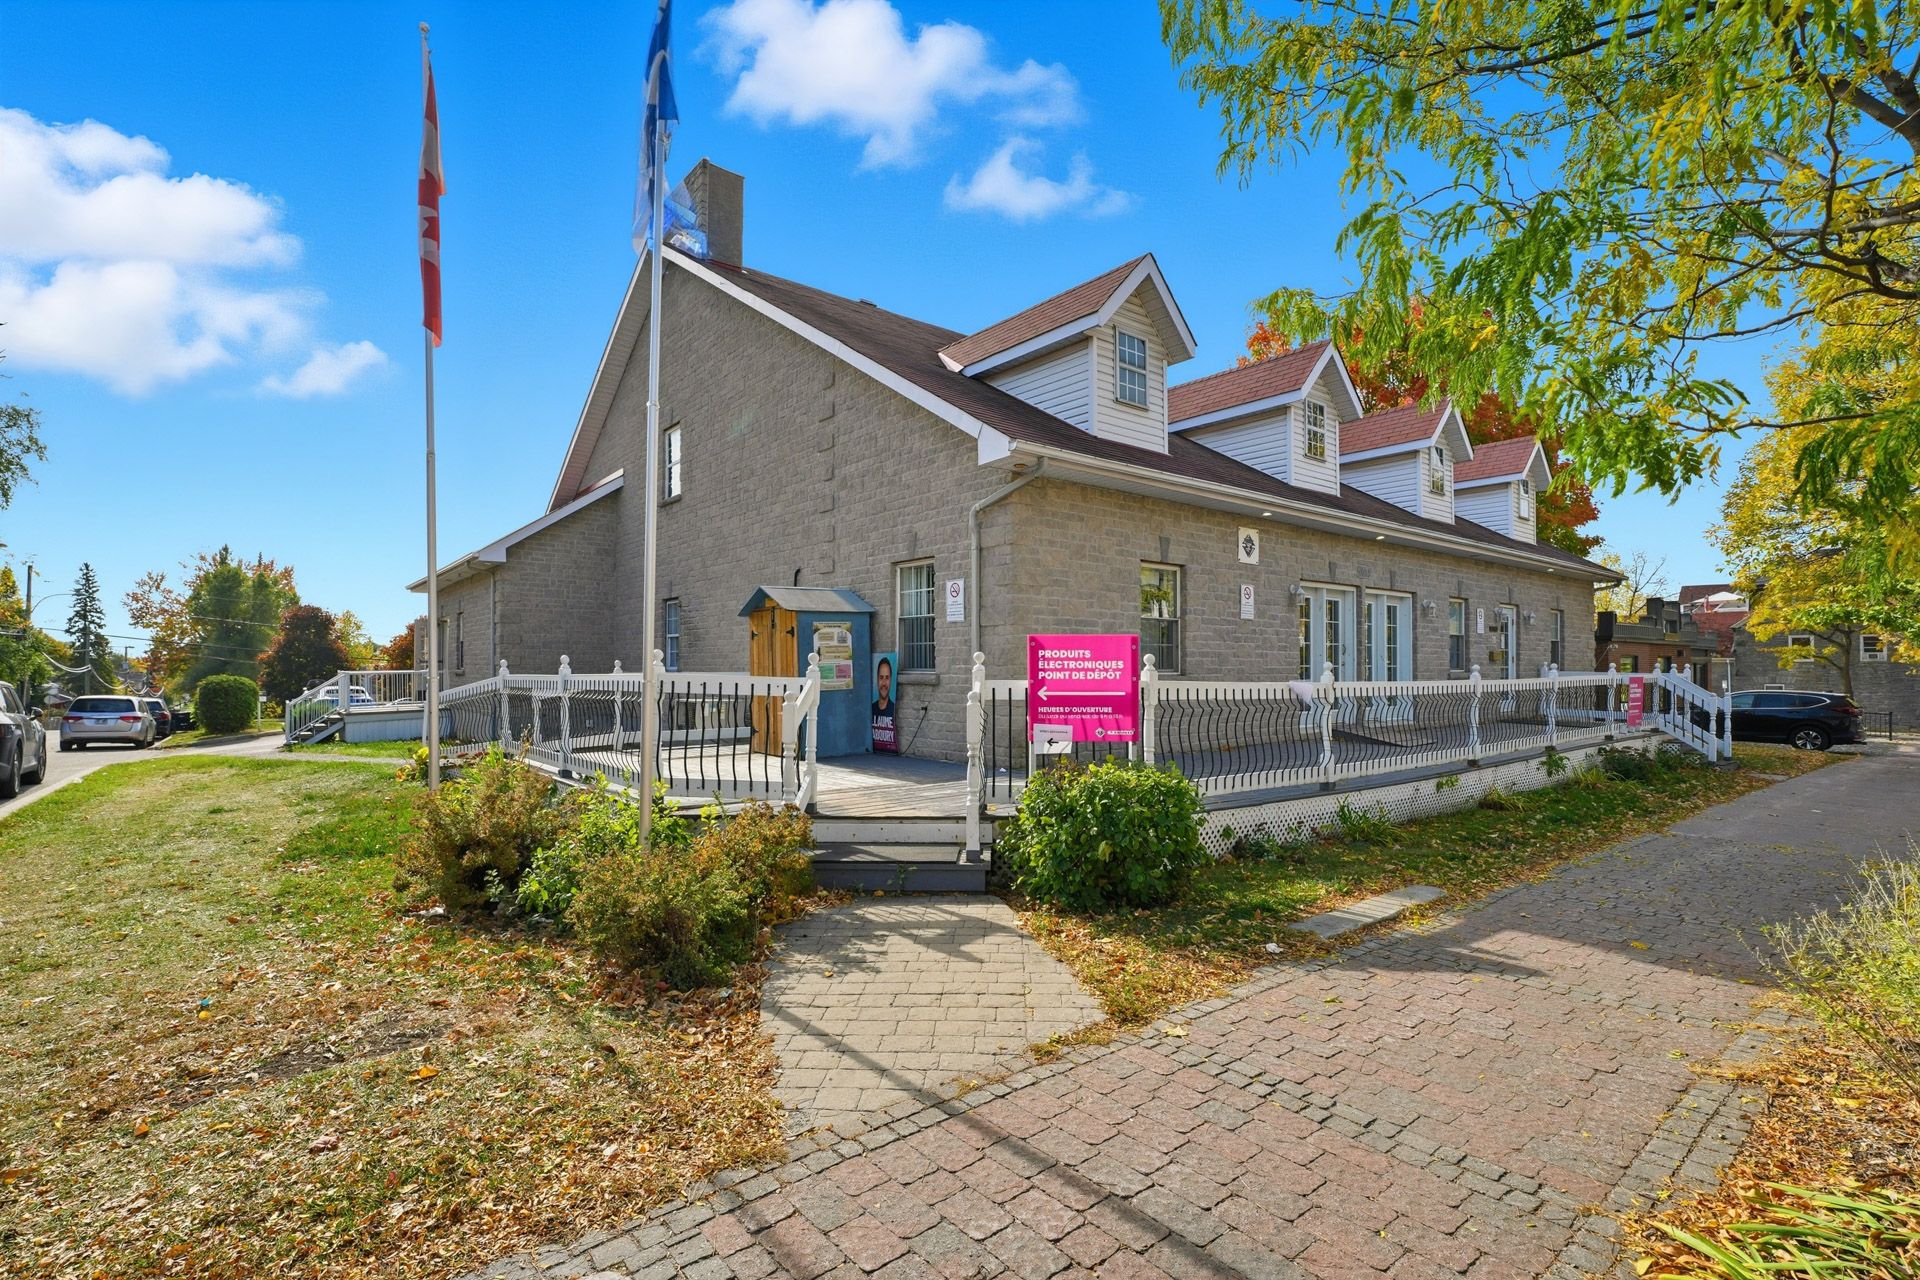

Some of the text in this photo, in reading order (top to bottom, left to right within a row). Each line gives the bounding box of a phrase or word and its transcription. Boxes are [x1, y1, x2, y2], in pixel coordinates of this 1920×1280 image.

[1038, 649, 1091, 658] PRODUITS
[1038, 658, 1124, 669] ÉLECTRONIQUES
[1038, 669, 1122, 680] POINT DE DÉPÔT
